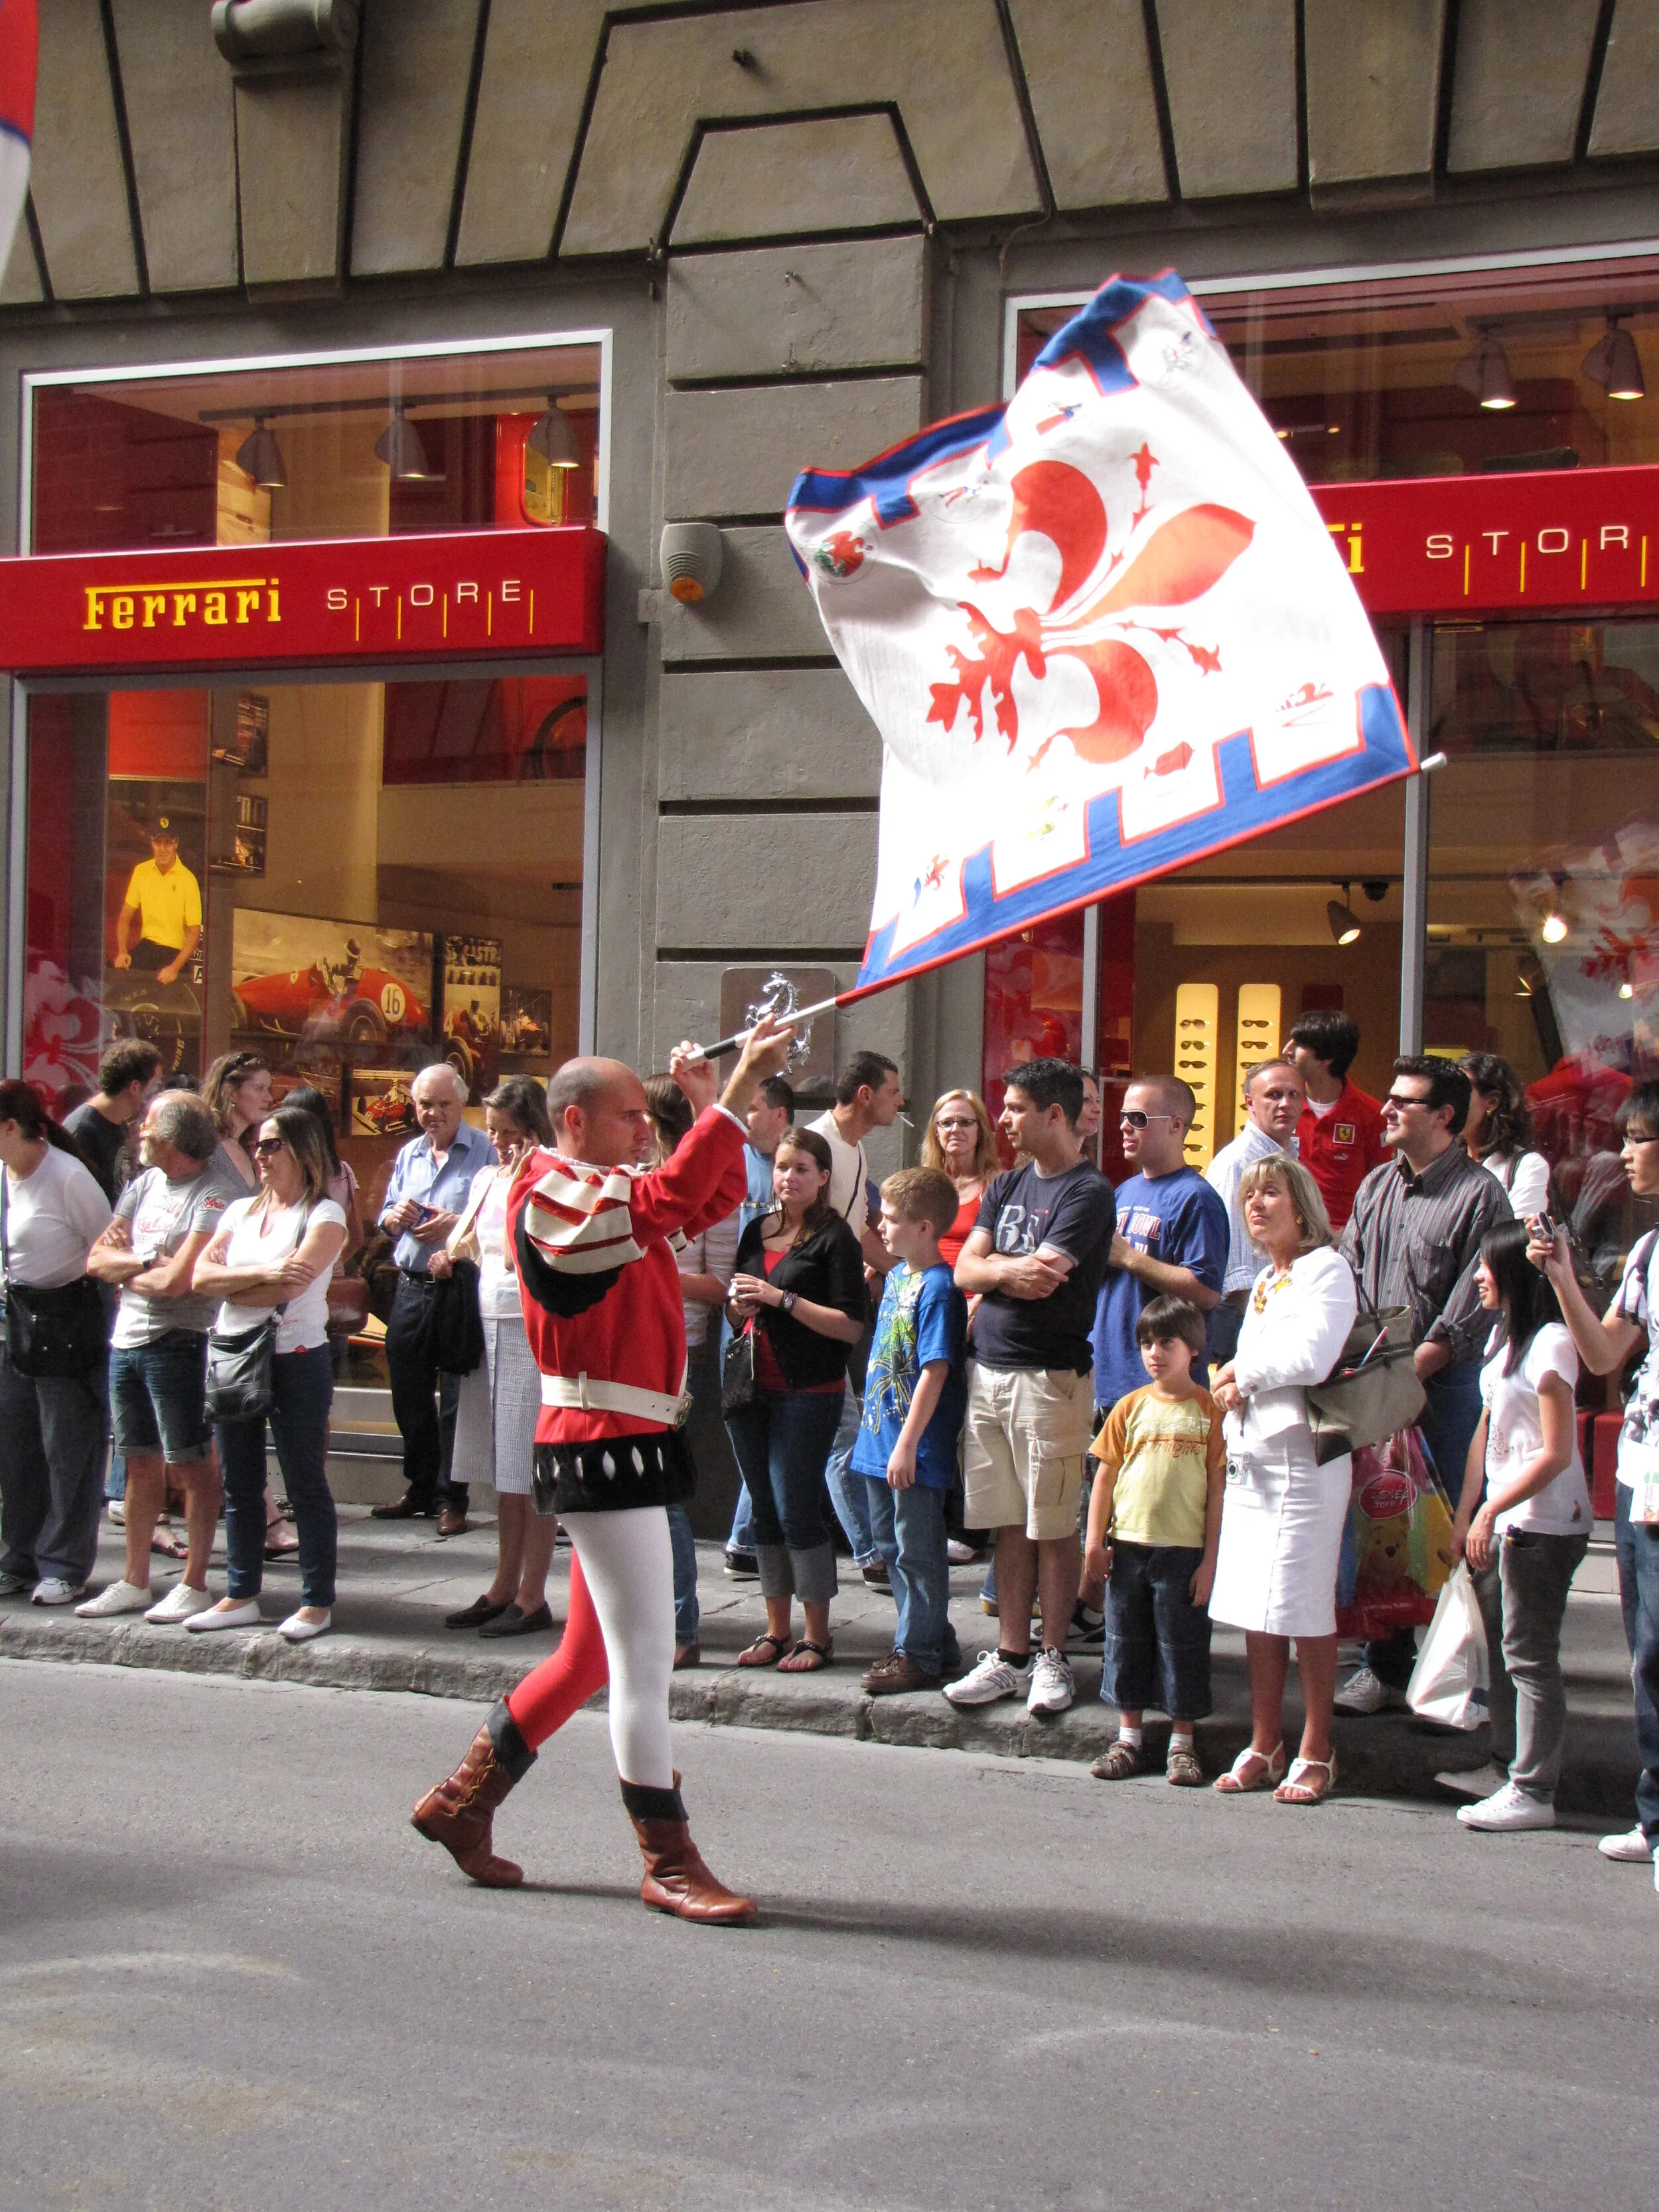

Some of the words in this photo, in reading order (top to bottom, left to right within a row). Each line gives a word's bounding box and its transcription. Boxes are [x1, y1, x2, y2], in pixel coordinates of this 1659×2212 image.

[83, 578, 281, 630] Ferrari
[327, 580, 521, 610] STORE
[384, 987, 401, 1015] 16
